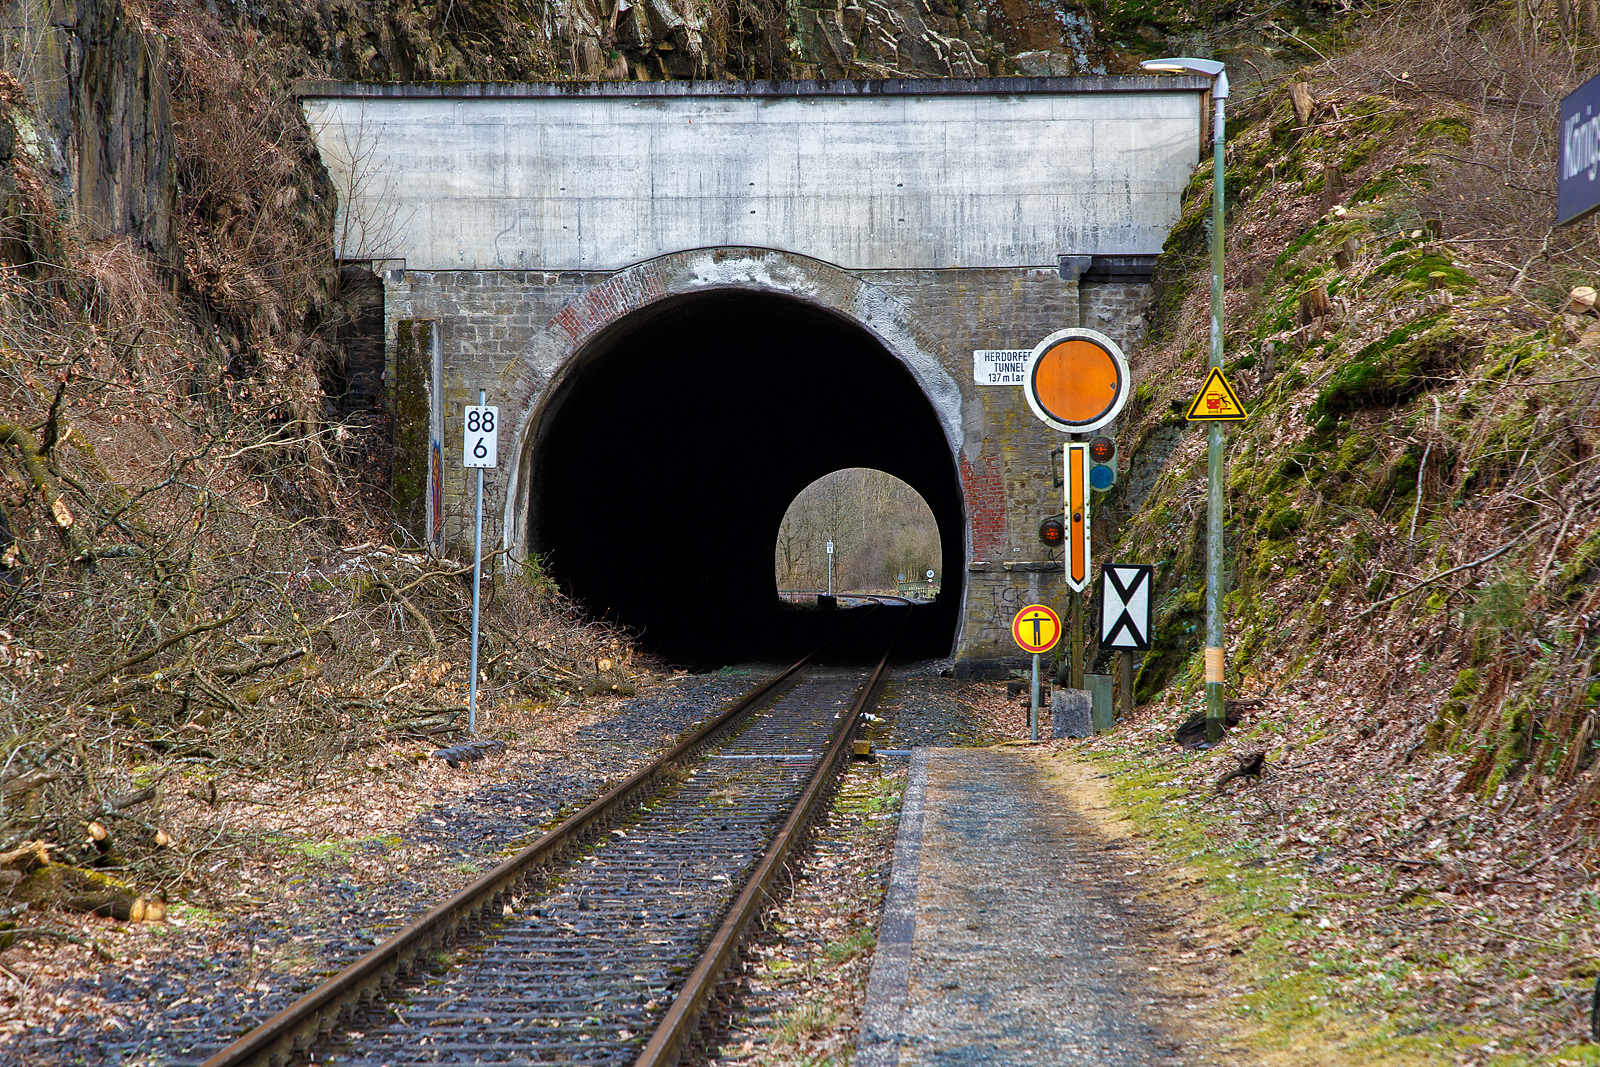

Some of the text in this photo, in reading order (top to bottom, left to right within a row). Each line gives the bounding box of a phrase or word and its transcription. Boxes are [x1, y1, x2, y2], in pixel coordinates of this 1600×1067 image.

[994, 362, 1025, 373] TUNNEL
[988, 373, 1001, 382] 137
[1002, 374, 1010, 382] m
[467, 410, 495, 433] 88
[473, 437, 488, 459] 6
